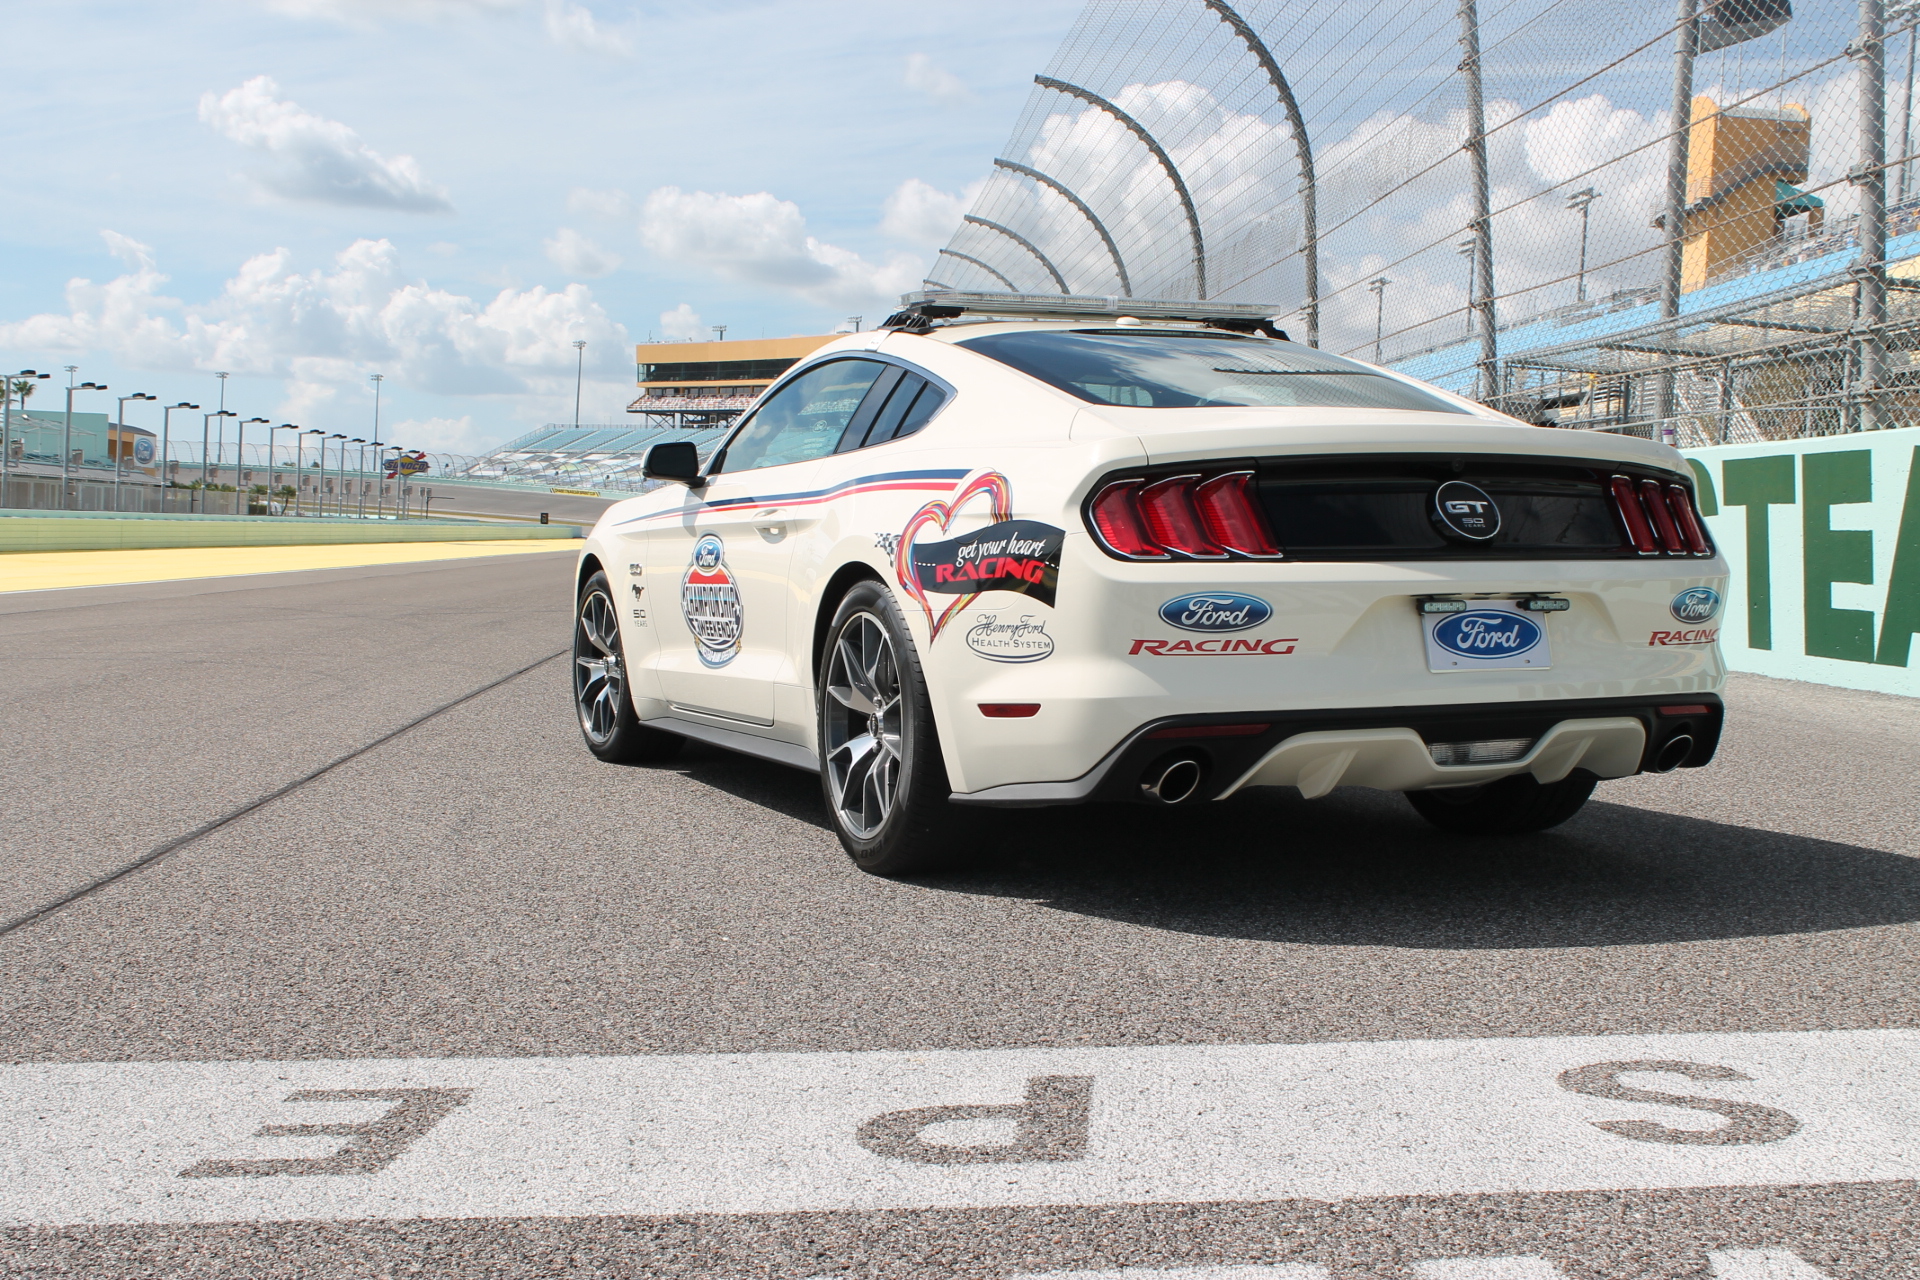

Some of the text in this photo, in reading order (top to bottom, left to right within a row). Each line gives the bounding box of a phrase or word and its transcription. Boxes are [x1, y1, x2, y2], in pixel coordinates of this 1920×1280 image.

[387, 461, 426, 471] SUNOCO
[1445, 501, 1488, 514] GT
[698, 544, 718, 566] Ford
[956, 531, 1047, 567] get your heart
[935, 557, 1046, 584] RACING
[685, 585, 736, 619] CHAMPIONSHIP
[1181, 597, 1252, 626] Ford
[1681, 592, 1716, 617] Ford
[633, 609, 646, 618] 50
[634, 620, 648, 628] YEARS
[700, 619, 733, 639] WEEKEND
[975, 613, 1046, 640] Henry Ford
[1456, 617, 1520, 649] Ford
[972, 637, 1051, 649] HEALTH SYSTEM
[1128, 638, 1299, 656] RACING
